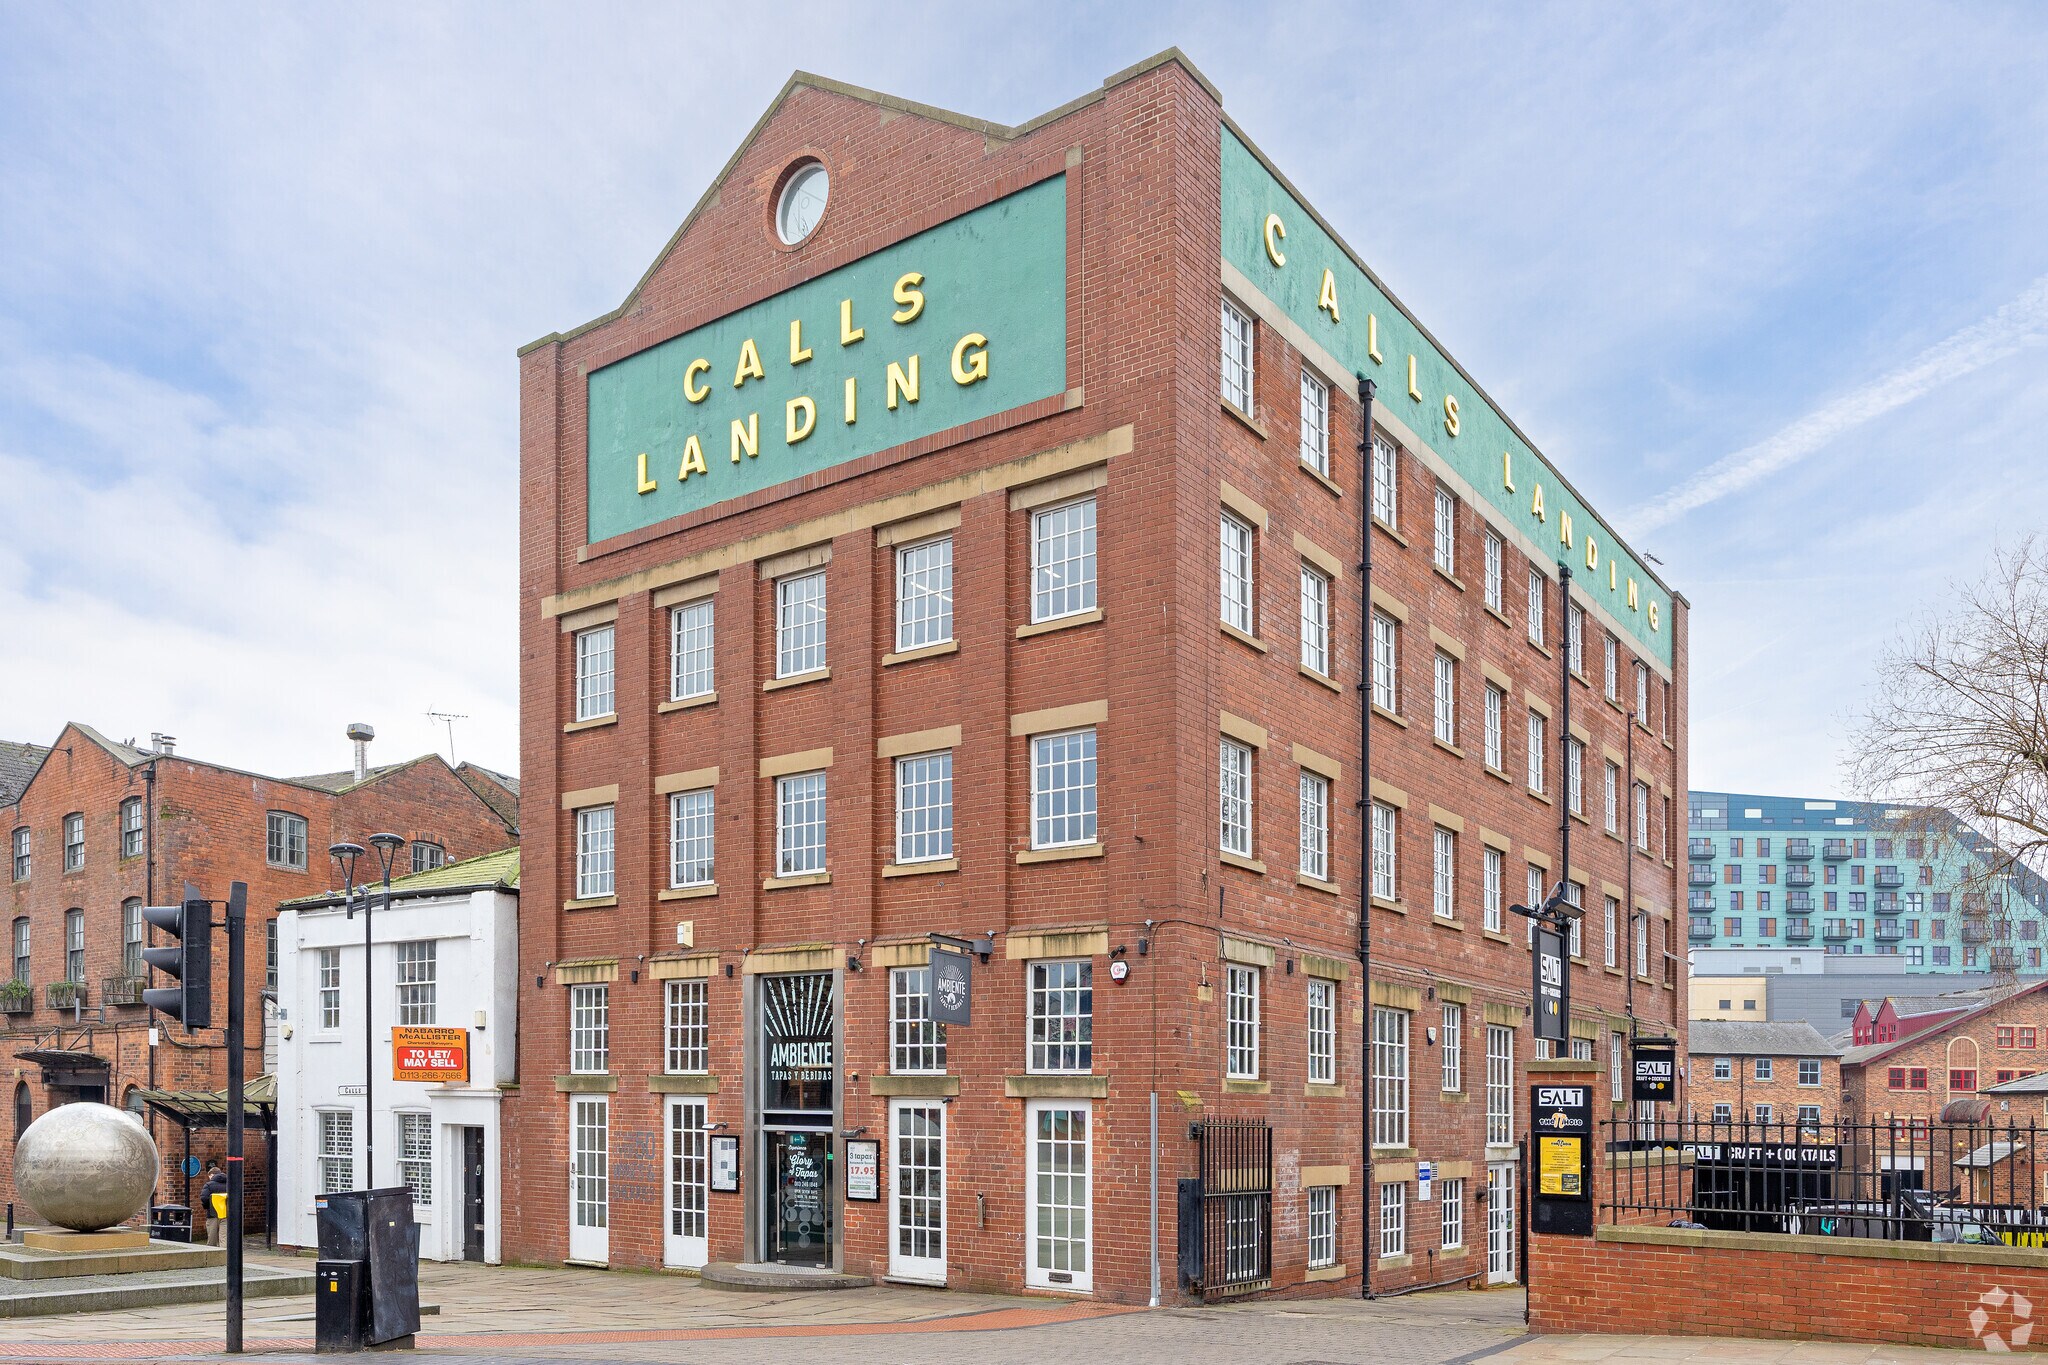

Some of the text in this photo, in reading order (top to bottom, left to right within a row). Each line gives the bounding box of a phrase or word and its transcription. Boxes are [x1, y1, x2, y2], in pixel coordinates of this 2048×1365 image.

[682, 271, 926, 404] CALLS
[636, 332, 989, 495] LANDING
[1263, 213, 1660, 632] CALLS LANDING
[938, 978, 965, 995] AMBIENTE
[409, 1050, 451, 1059] TO LET/
[771, 1042, 832, 1067] AMBIENTE
[404, 1059, 457, 1067] MAY SELL
[1638, 1063, 1670, 1074] SALT
[771, 1071, 832, 1080] TAPAS Y BEBIDAS
[1541, 1090, 1581, 1105] SALT
[789, 1154, 813, 1168] Glory
[850, 1152, 873, 1161] 3 tapas
[795, 1167, 818, 1179] Tapas
[850, 1166, 875, 1175] 17.95
